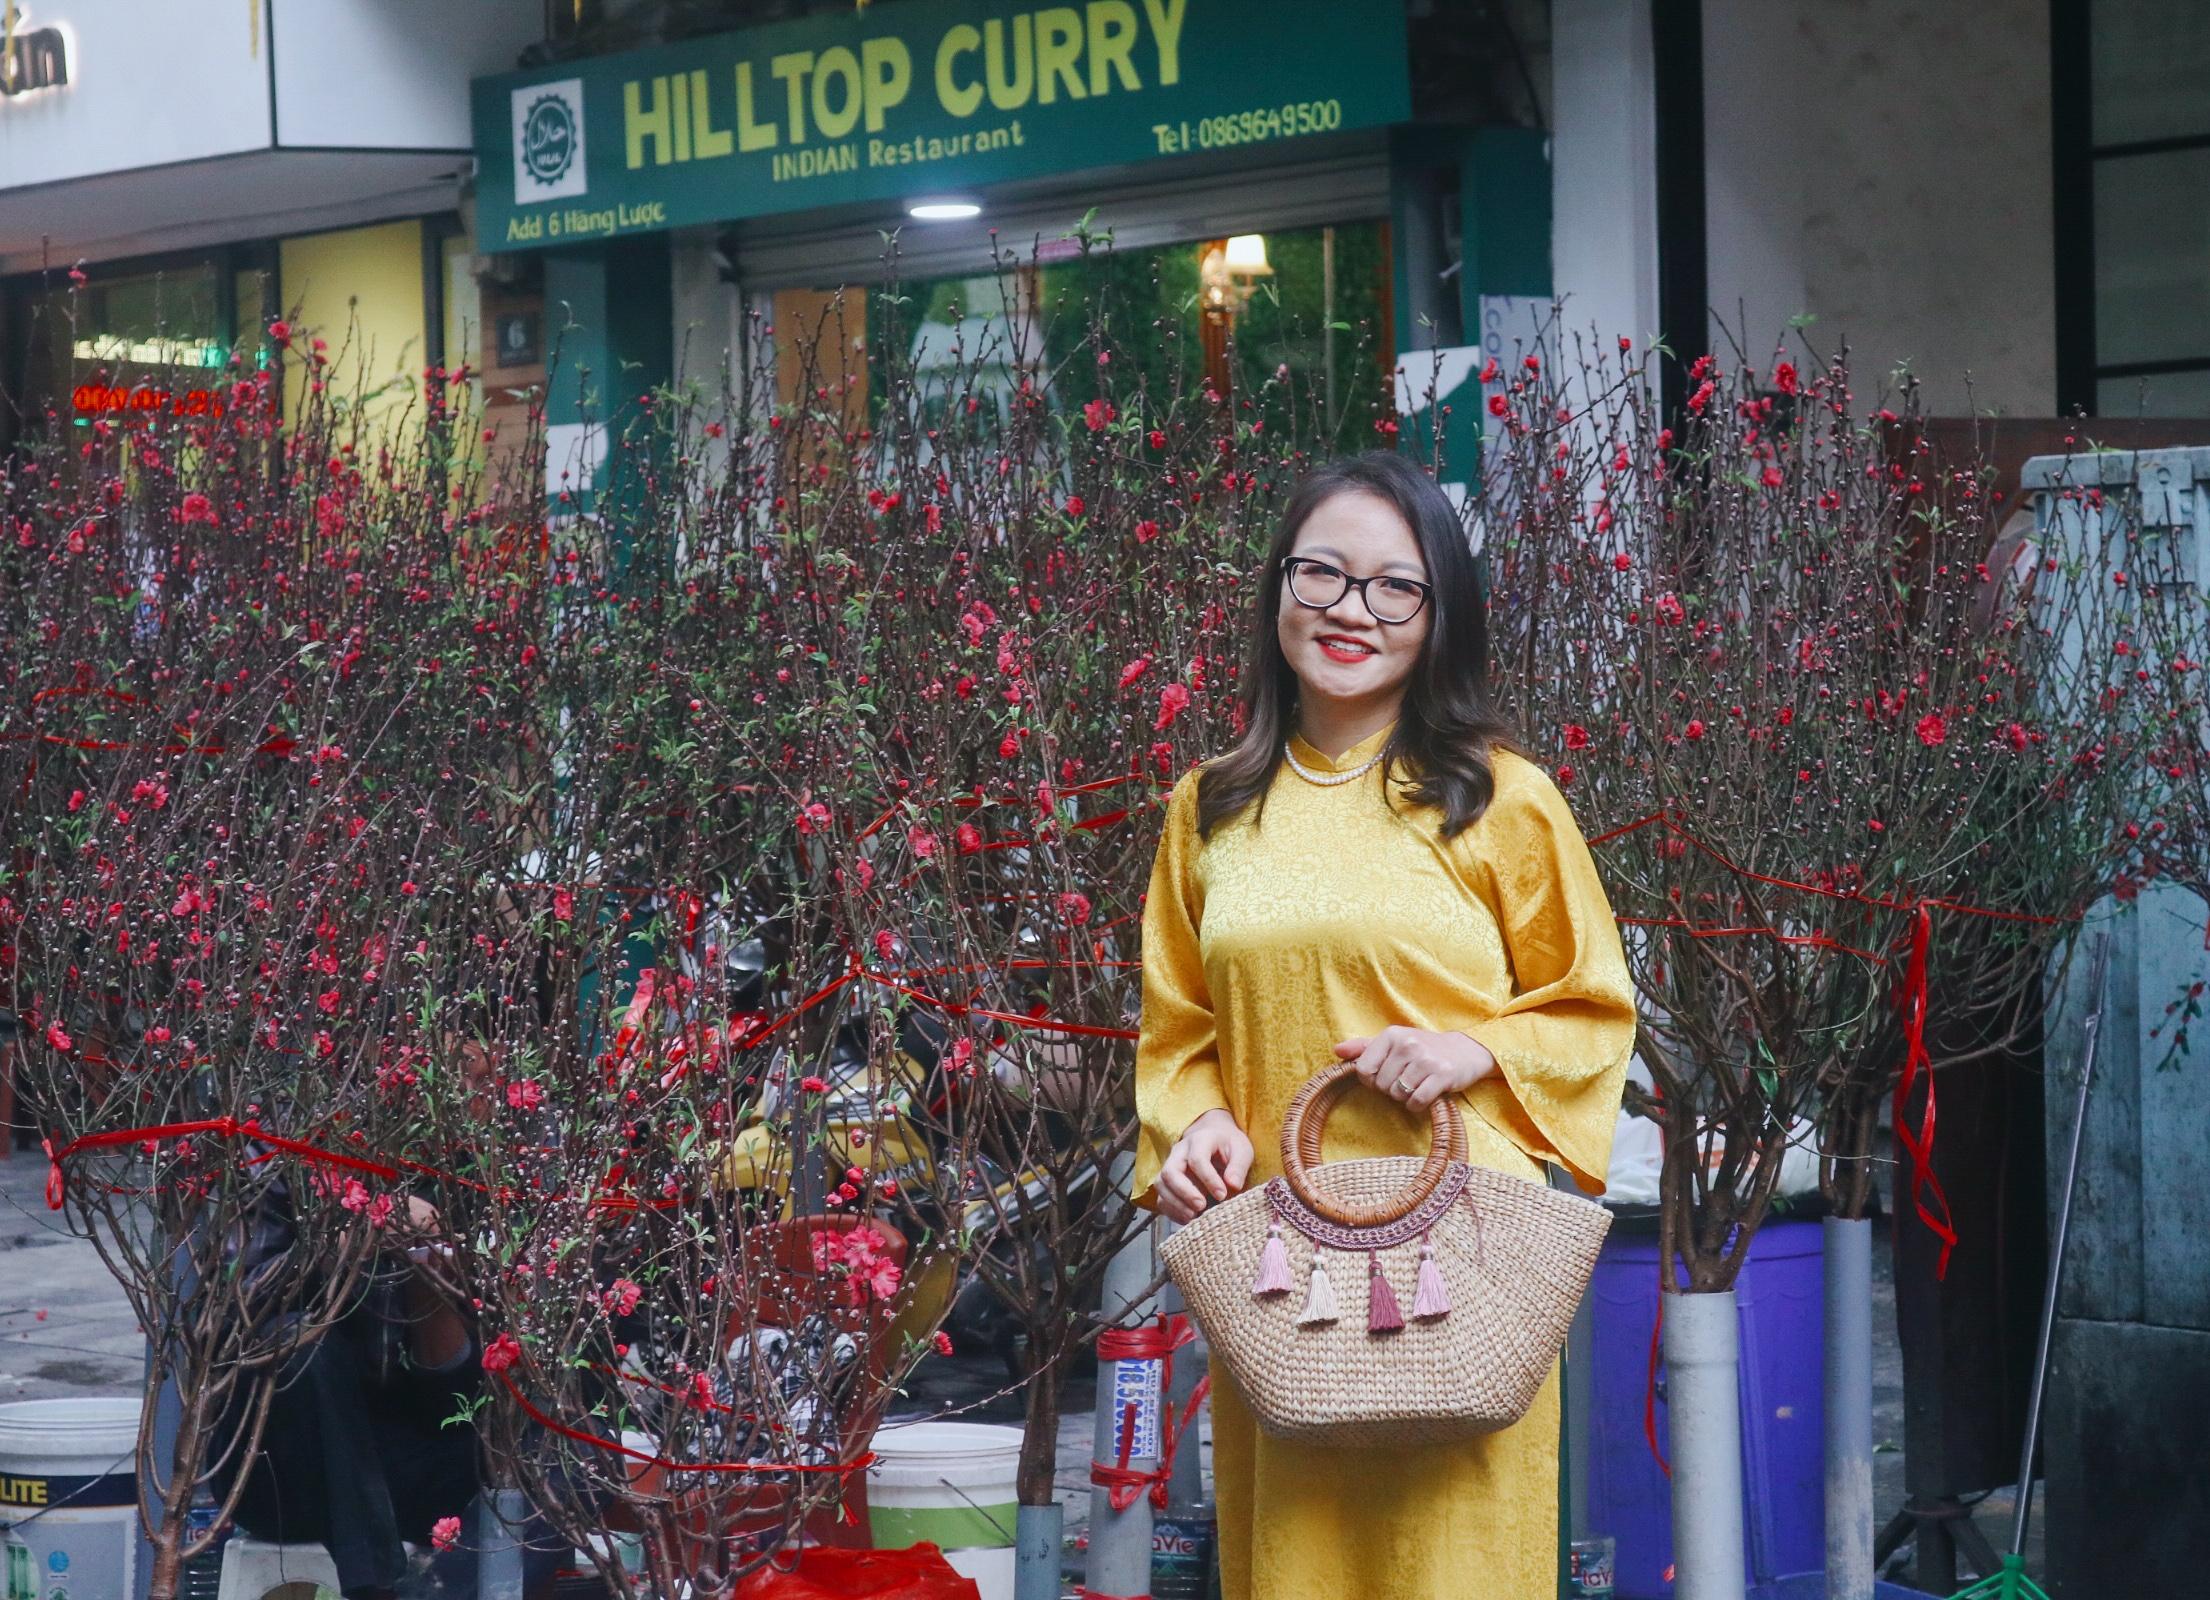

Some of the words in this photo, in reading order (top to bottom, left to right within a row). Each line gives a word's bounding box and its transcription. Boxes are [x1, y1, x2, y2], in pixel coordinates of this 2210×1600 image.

[624, 36, 912, 169] HILLTOP
[935, 0, 1187, 118] CURRY
[773, 144, 858, 181] INDIAN
[869, 120, 1024, 167] Restaurant
[549, 211, 561, 236] 6
[1152, 1533, 1195, 1554] aVie
